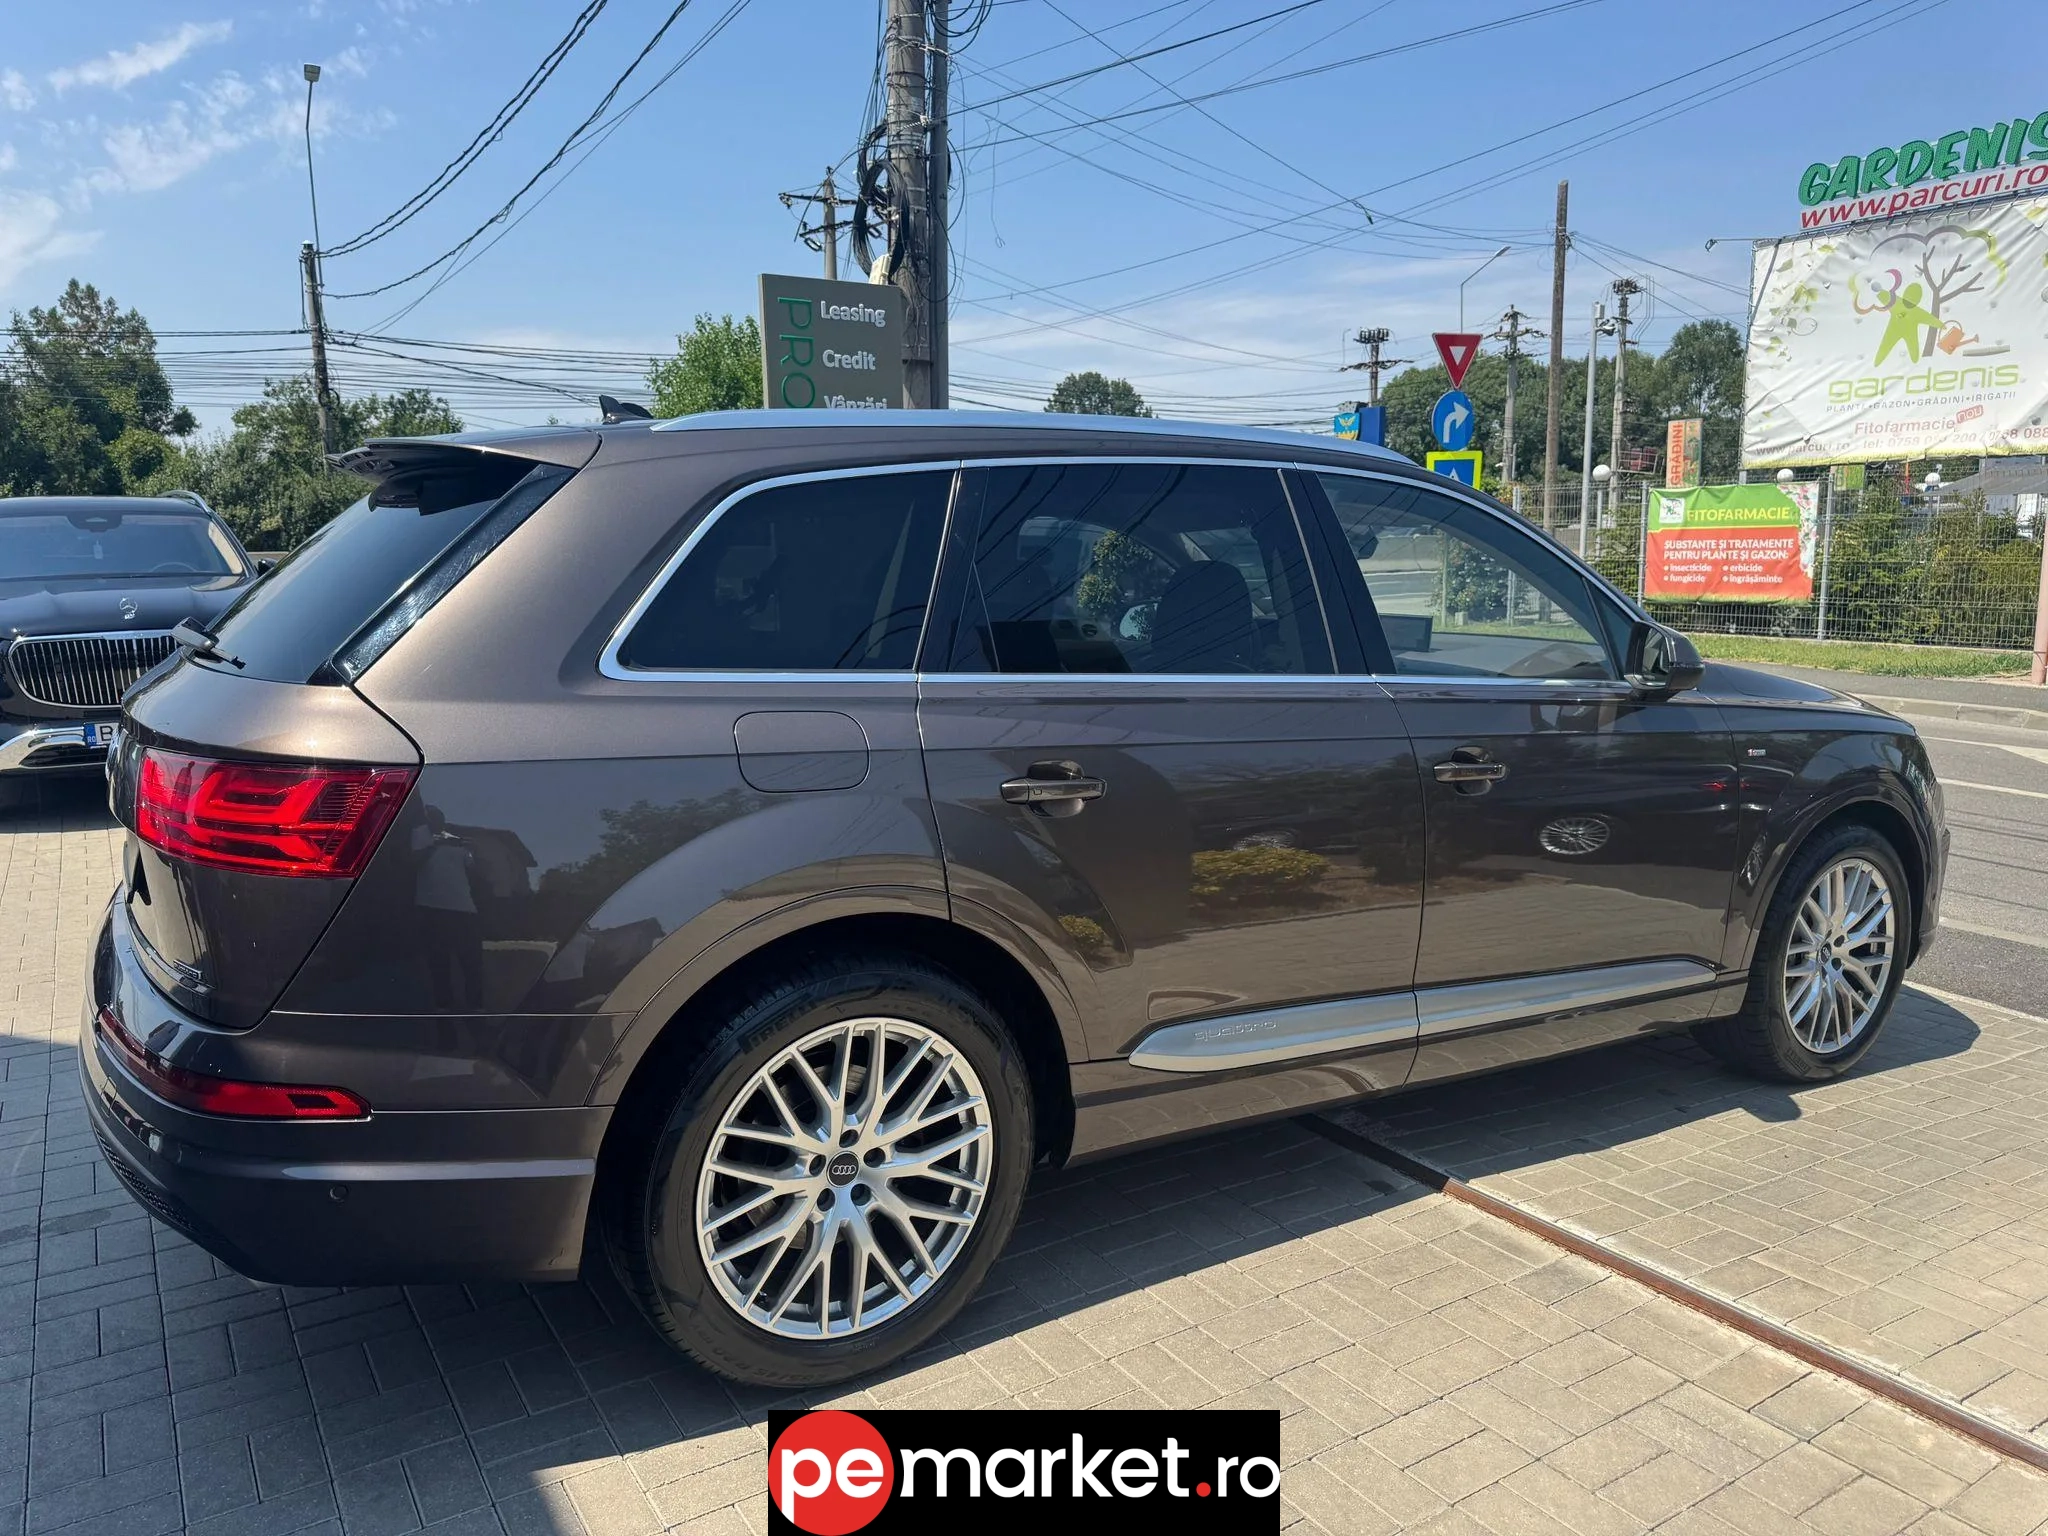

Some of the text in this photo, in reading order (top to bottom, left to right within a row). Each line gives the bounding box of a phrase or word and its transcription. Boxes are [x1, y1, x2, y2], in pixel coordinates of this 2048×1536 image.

[1801, 164, 2048, 228] www.parcuri.ro
[820, 300, 886, 328] Leasing
[822, 349, 876, 370] Credit
[1828, 364, 2019, 404] gardenis
[1854, 417, 1956, 435] Fitofarmacie
[1686, 507, 1790, 521] FITOFARMACIE
[1728, 538, 1794, 549] TRATAMENTE
[1664, 550, 1700, 560] PENTRU
[1701, 550, 1738, 560] PLANTE
[1751, 549, 1789, 560] GAZON:
[1669, 563, 1713, 572] insecticide
[1729, 562, 1764, 573] erbicide
[1669, 573, 1706, 584] fungicide
